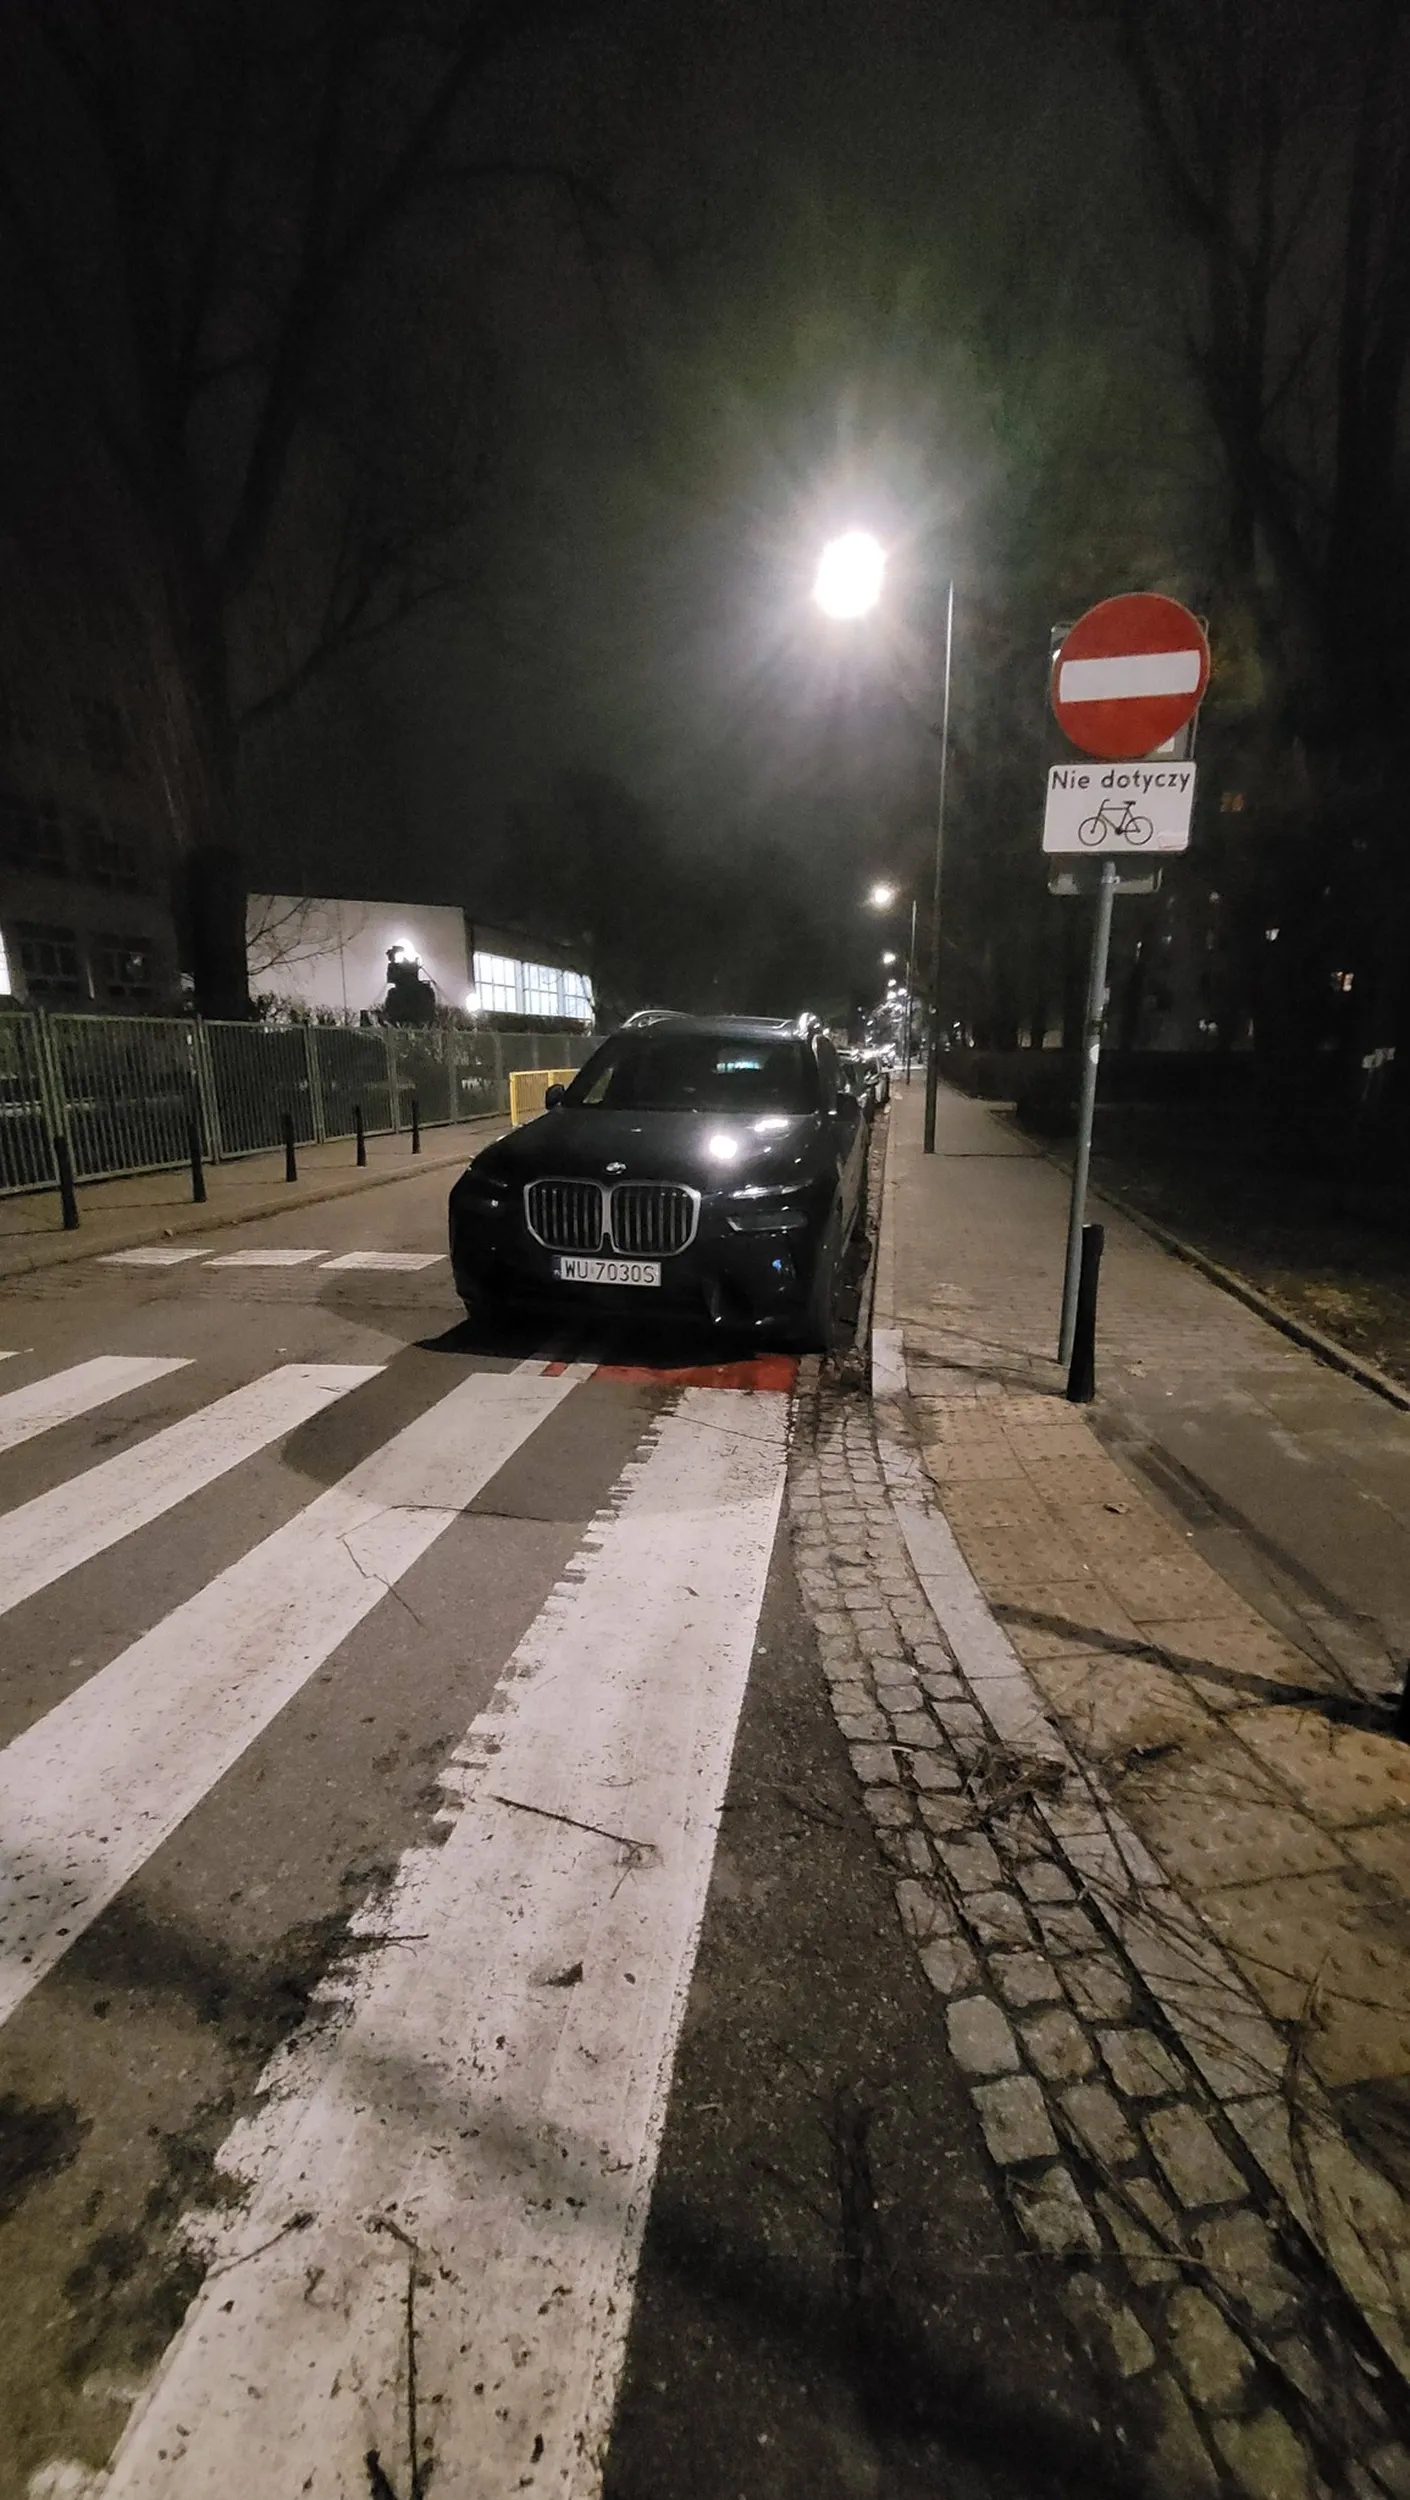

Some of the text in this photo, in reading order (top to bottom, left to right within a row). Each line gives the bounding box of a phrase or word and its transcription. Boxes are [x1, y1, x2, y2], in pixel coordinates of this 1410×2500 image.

[1052, 769, 1191, 794] Nie dotyczy
[565, 1260, 588, 1279] WU
[595, 1262, 655, 1284] 7030S
